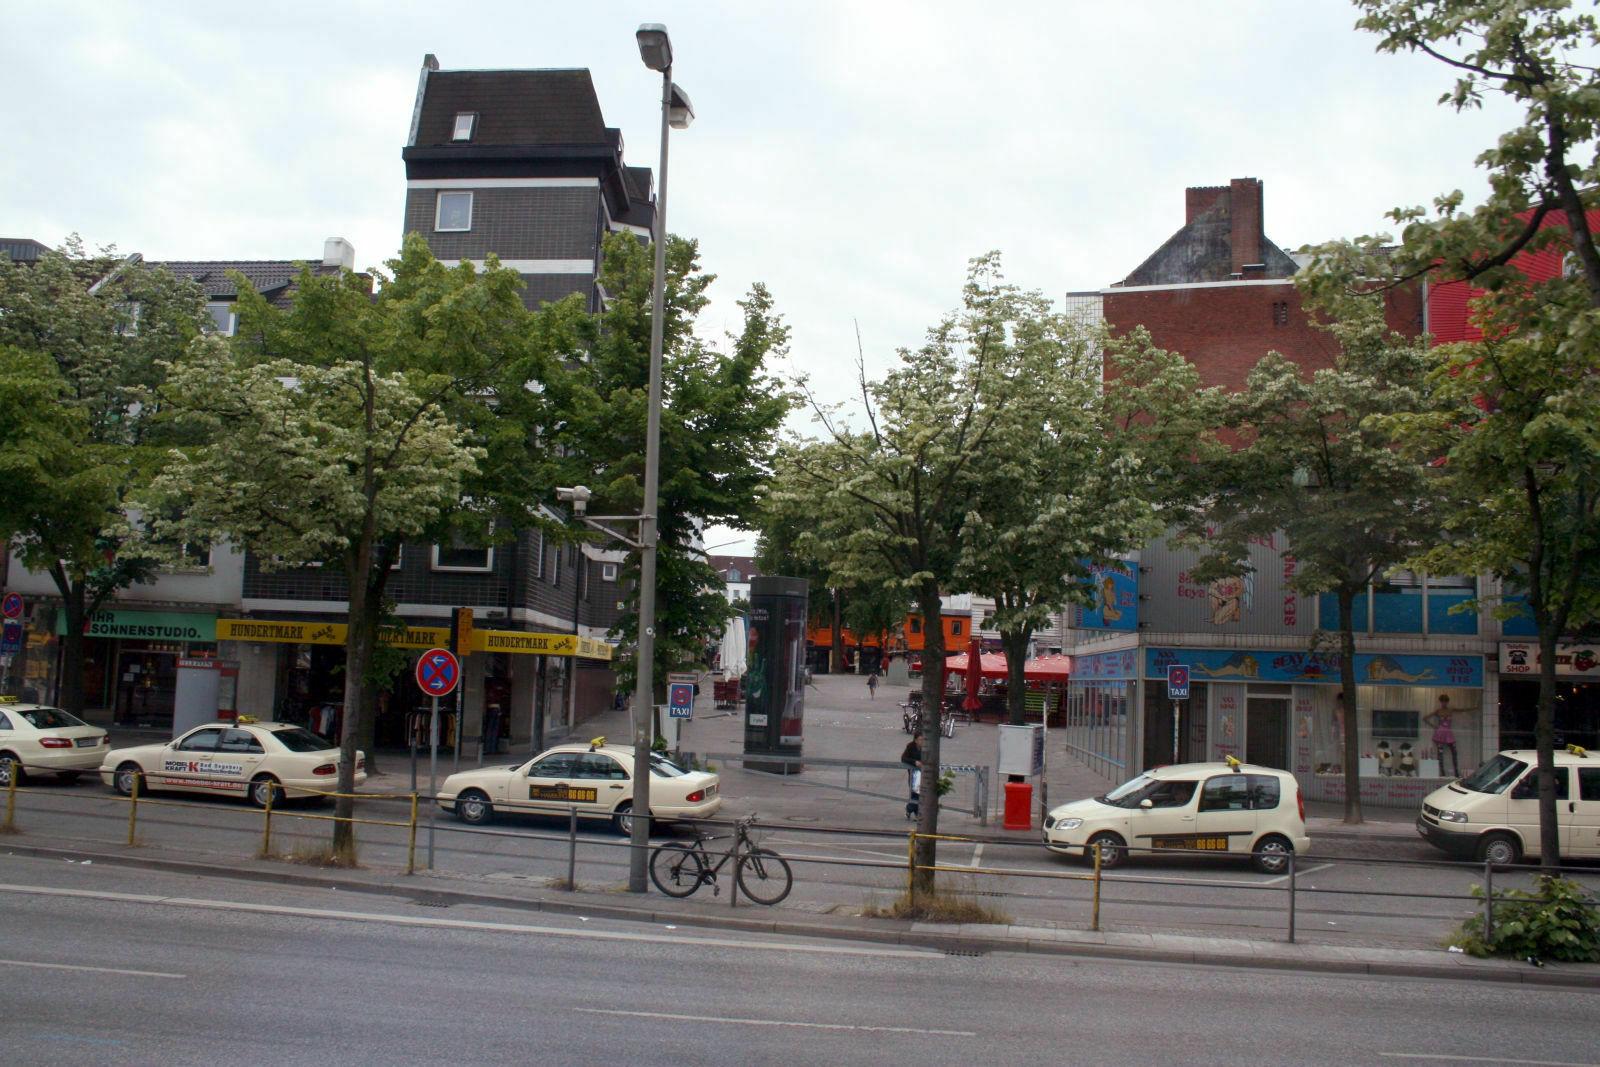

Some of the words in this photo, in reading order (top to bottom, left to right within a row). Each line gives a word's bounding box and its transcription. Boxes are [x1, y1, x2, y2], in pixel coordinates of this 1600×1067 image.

[91, 612, 115, 622] IHR
[91, 624, 202, 638] SONNENSTUDIO.
[230, 623, 304, 639] HUNDERTMARK
[488, 635, 549, 650] HUNDERTMARK
[1506, 665, 1530, 673] SHOP
[1170, 688, 1187, 696] TAXI
[671, 707, 690, 715] TAXI
